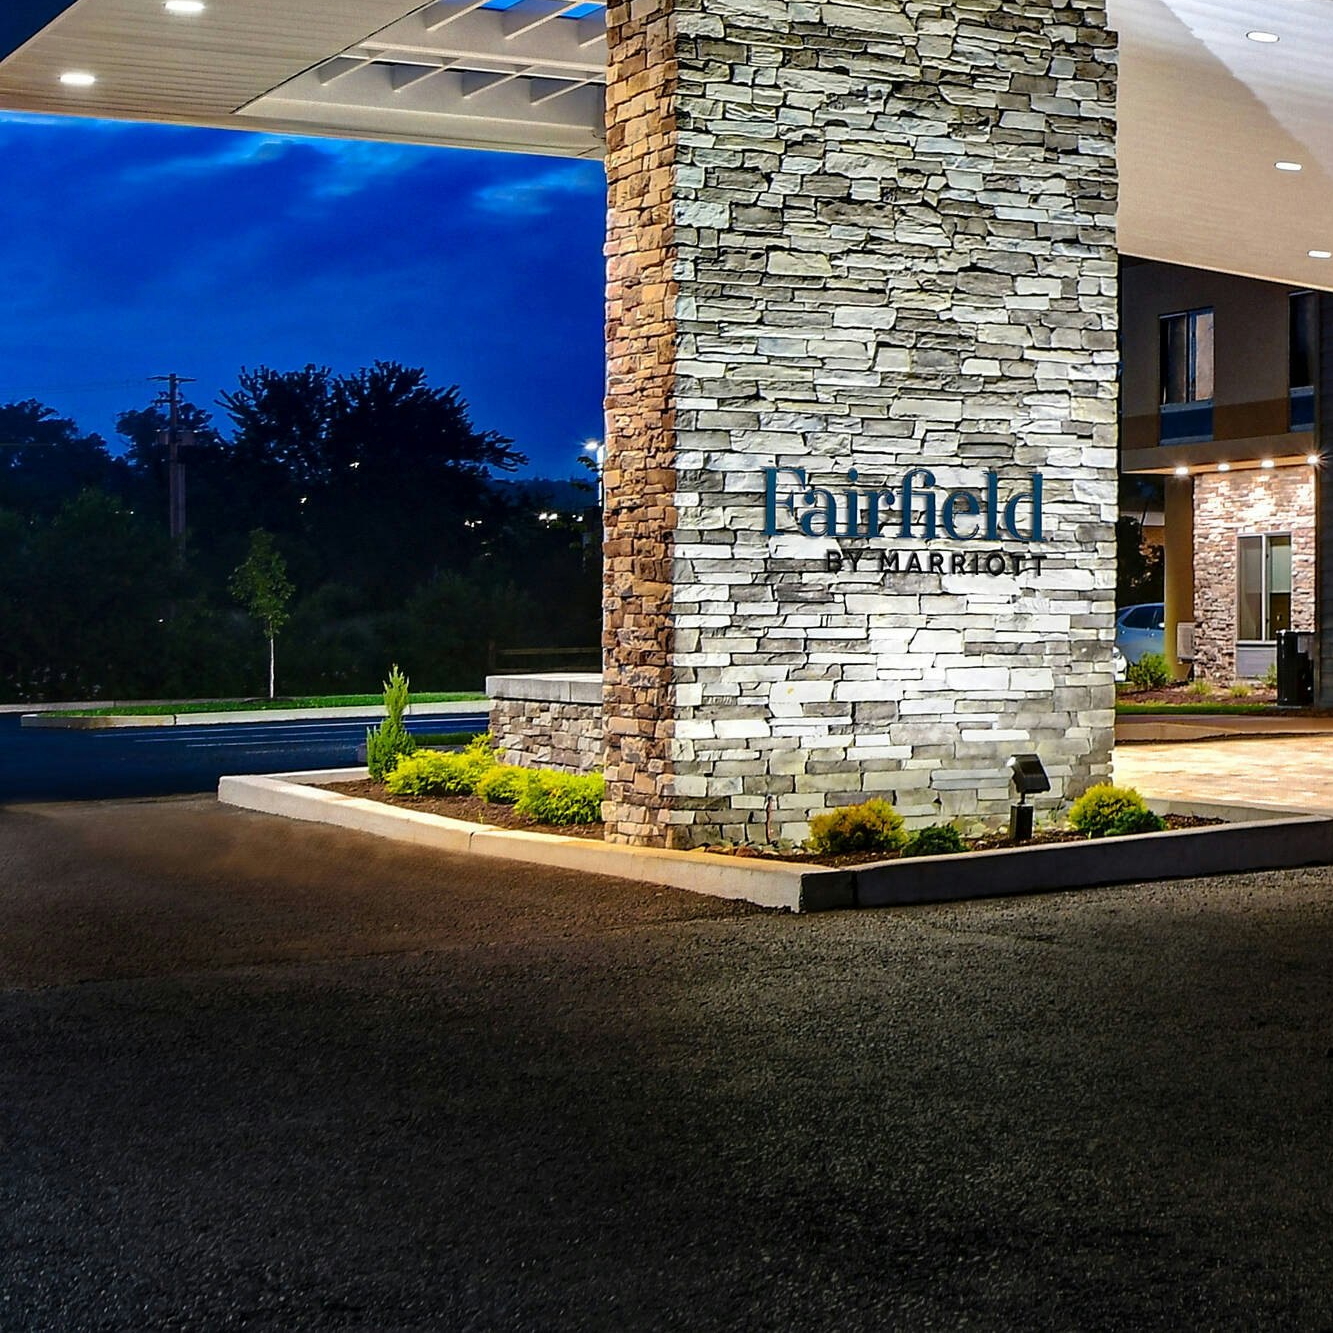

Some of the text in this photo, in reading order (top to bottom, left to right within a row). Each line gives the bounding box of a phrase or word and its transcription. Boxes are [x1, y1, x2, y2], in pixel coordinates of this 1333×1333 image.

[760, 466, 1047, 543] Fairfield
[826, 549, 1047, 577] BY MARRIOTT
